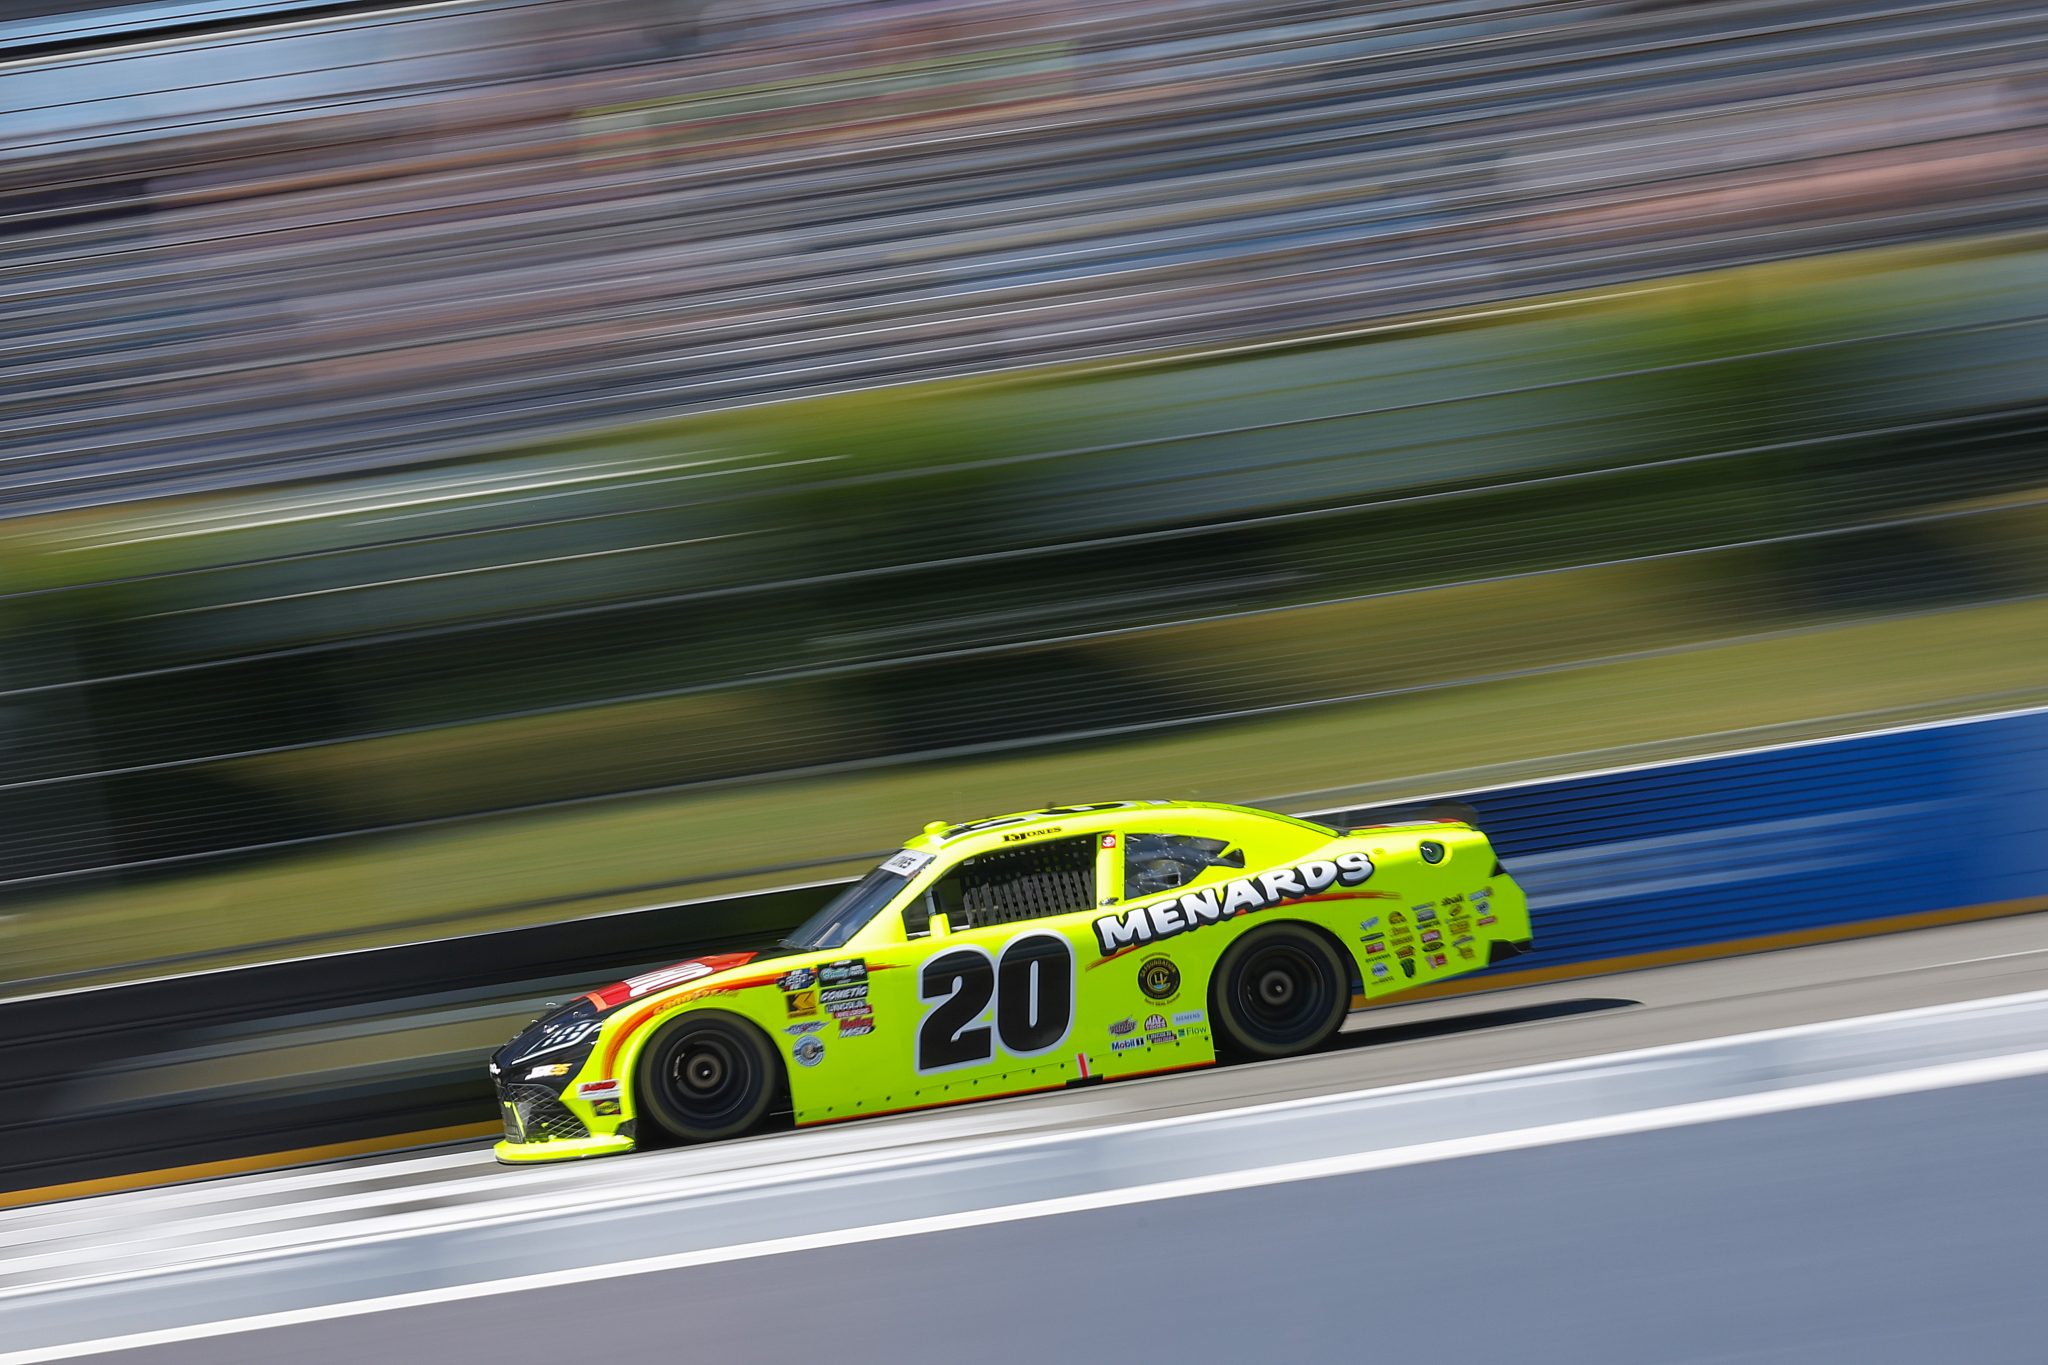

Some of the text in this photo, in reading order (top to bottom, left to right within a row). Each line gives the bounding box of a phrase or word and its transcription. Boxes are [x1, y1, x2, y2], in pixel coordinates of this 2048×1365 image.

[1094, 851, 1375, 955] MENARDS
[820, 985, 868, 1002] COMETIC
[917, 931, 1074, 1072] 20
[1186, 1026, 1207, 1036] Flow
[1112, 1039, 1135, 1051] Mobil
